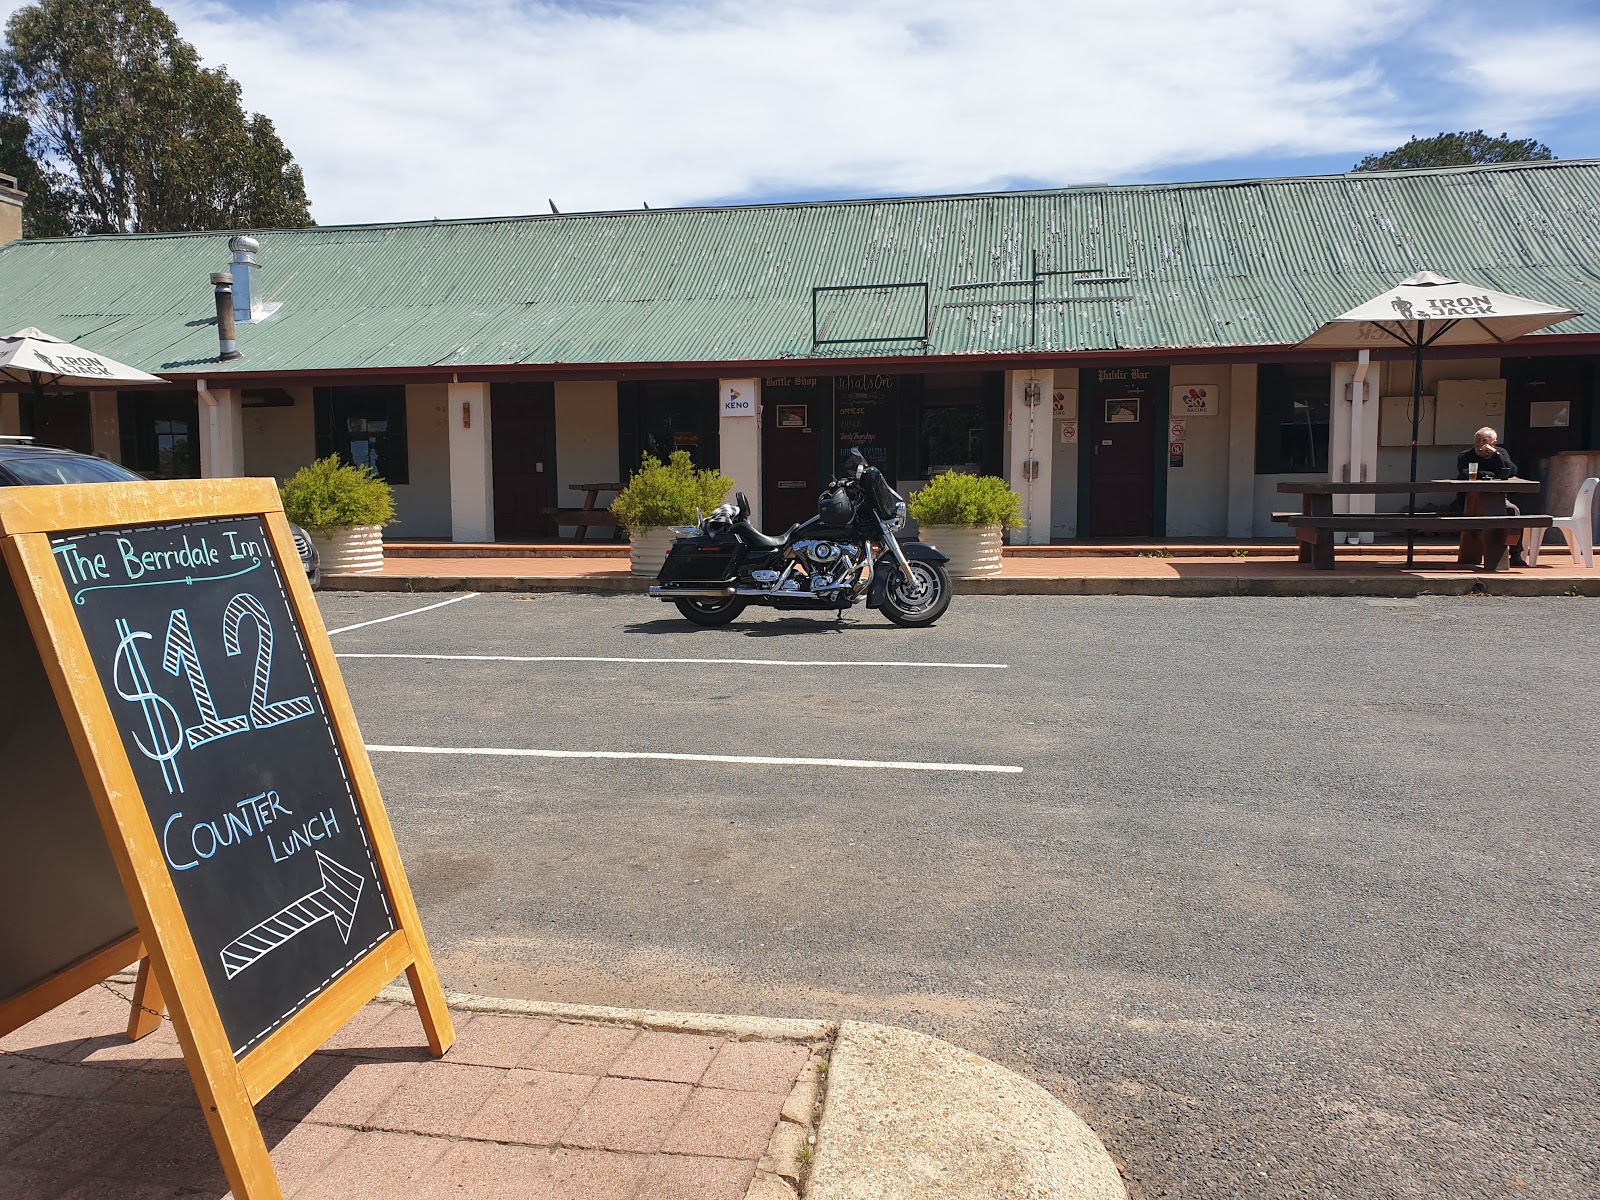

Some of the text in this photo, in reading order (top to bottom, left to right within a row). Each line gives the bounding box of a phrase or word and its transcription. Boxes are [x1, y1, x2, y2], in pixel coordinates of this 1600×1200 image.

[1426, 296, 1492, 308] IRON
[1431, 306, 1497, 316] JACK
[56, 356, 104, 366] IRON
[71, 365, 115, 376] JACK
[1098, 368, 1150, 383] Public Bar
[766, 376, 817, 388] Bottle Shop
[725, 401, 749, 410] KENO
[1185, 397, 1205, 408] SKY
[53, 531, 262, 585] The Berridale Inn
[113, 593, 315, 794] $12
[163, 789, 293, 872] COUNTER
[266, 806, 341, 864] LUNCH
